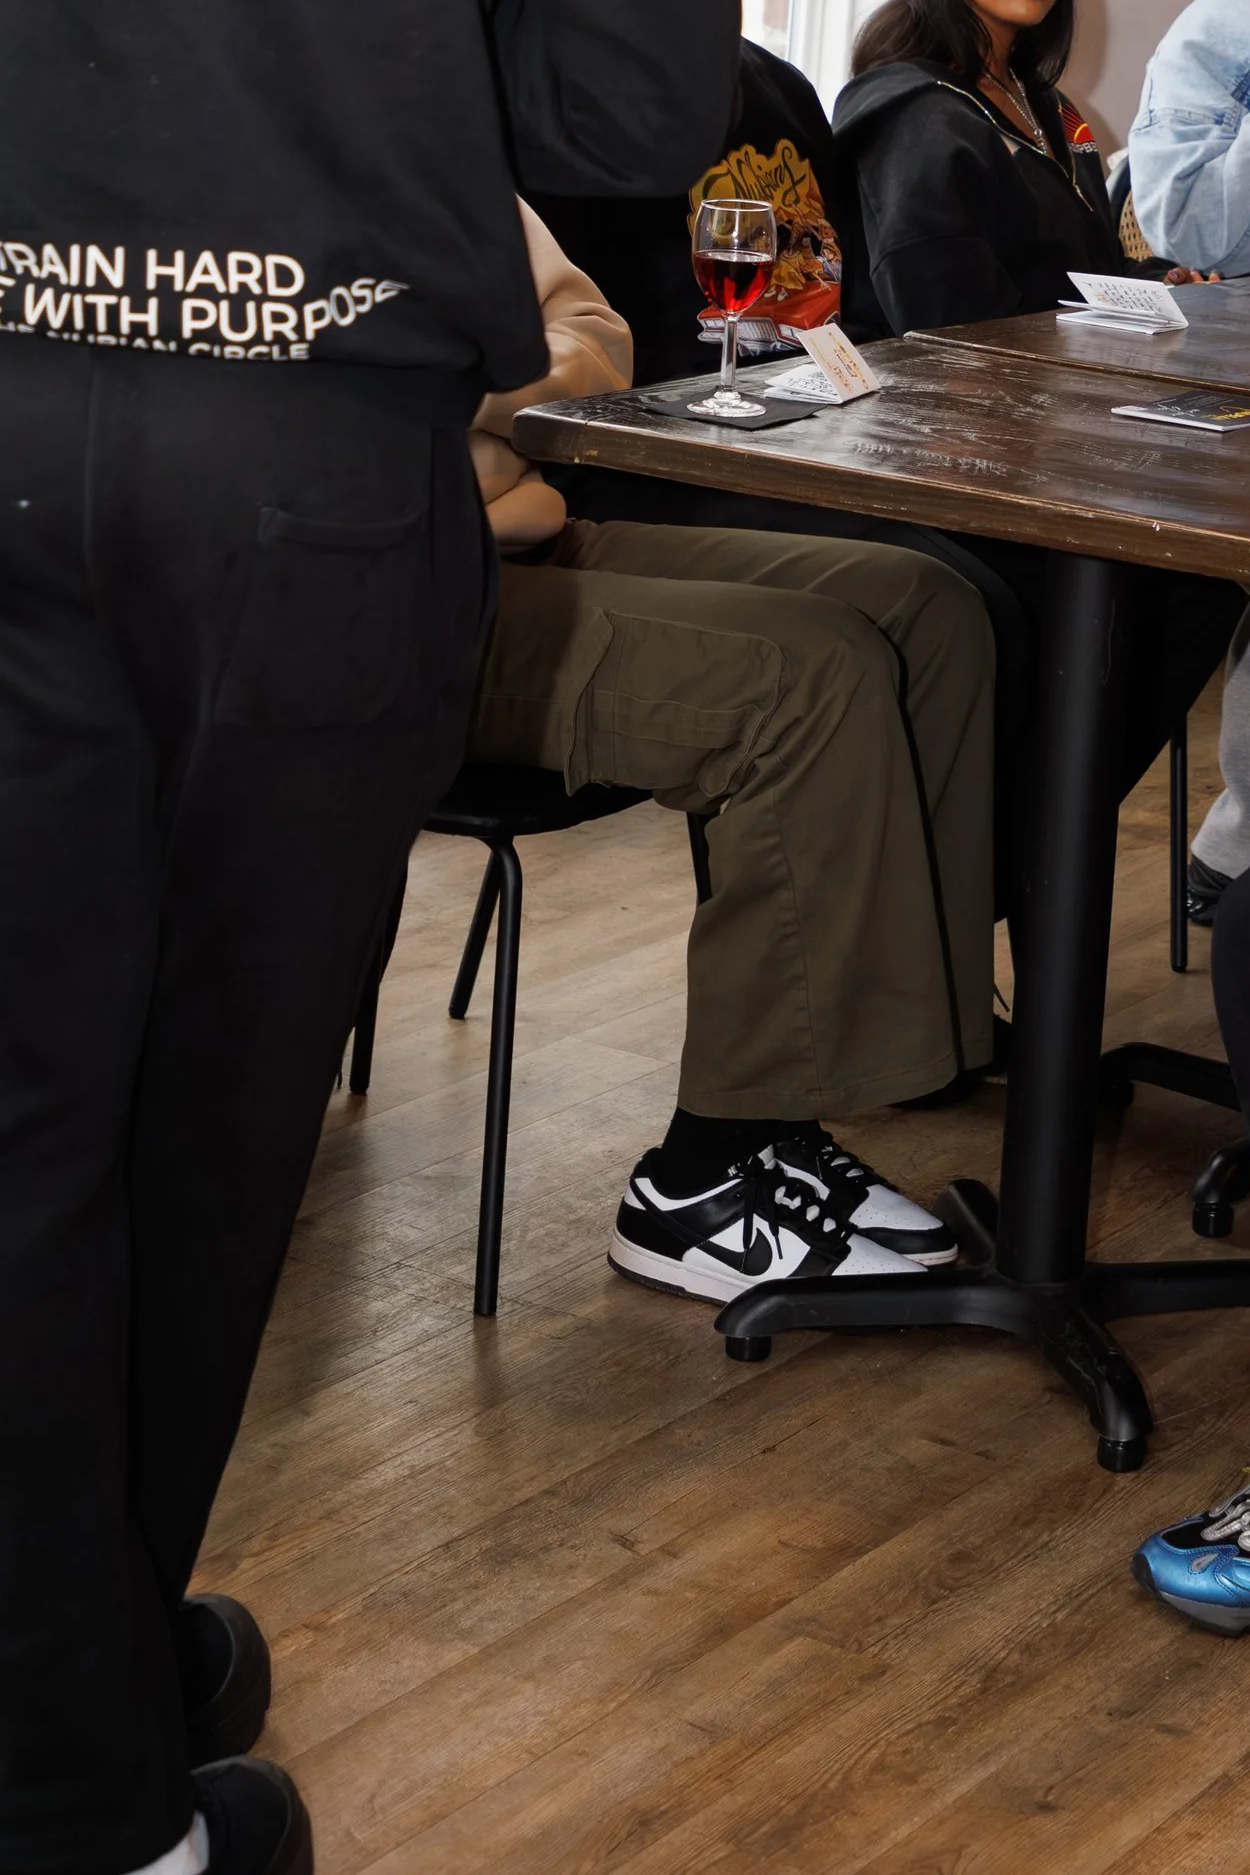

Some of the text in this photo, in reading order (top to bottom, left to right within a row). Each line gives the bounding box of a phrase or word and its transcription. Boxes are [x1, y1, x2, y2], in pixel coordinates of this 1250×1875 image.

[145, 247, 305, 297] HARD
[24, 283, 159, 338] WITH
[181, 277, 410, 342] PURPOSE
